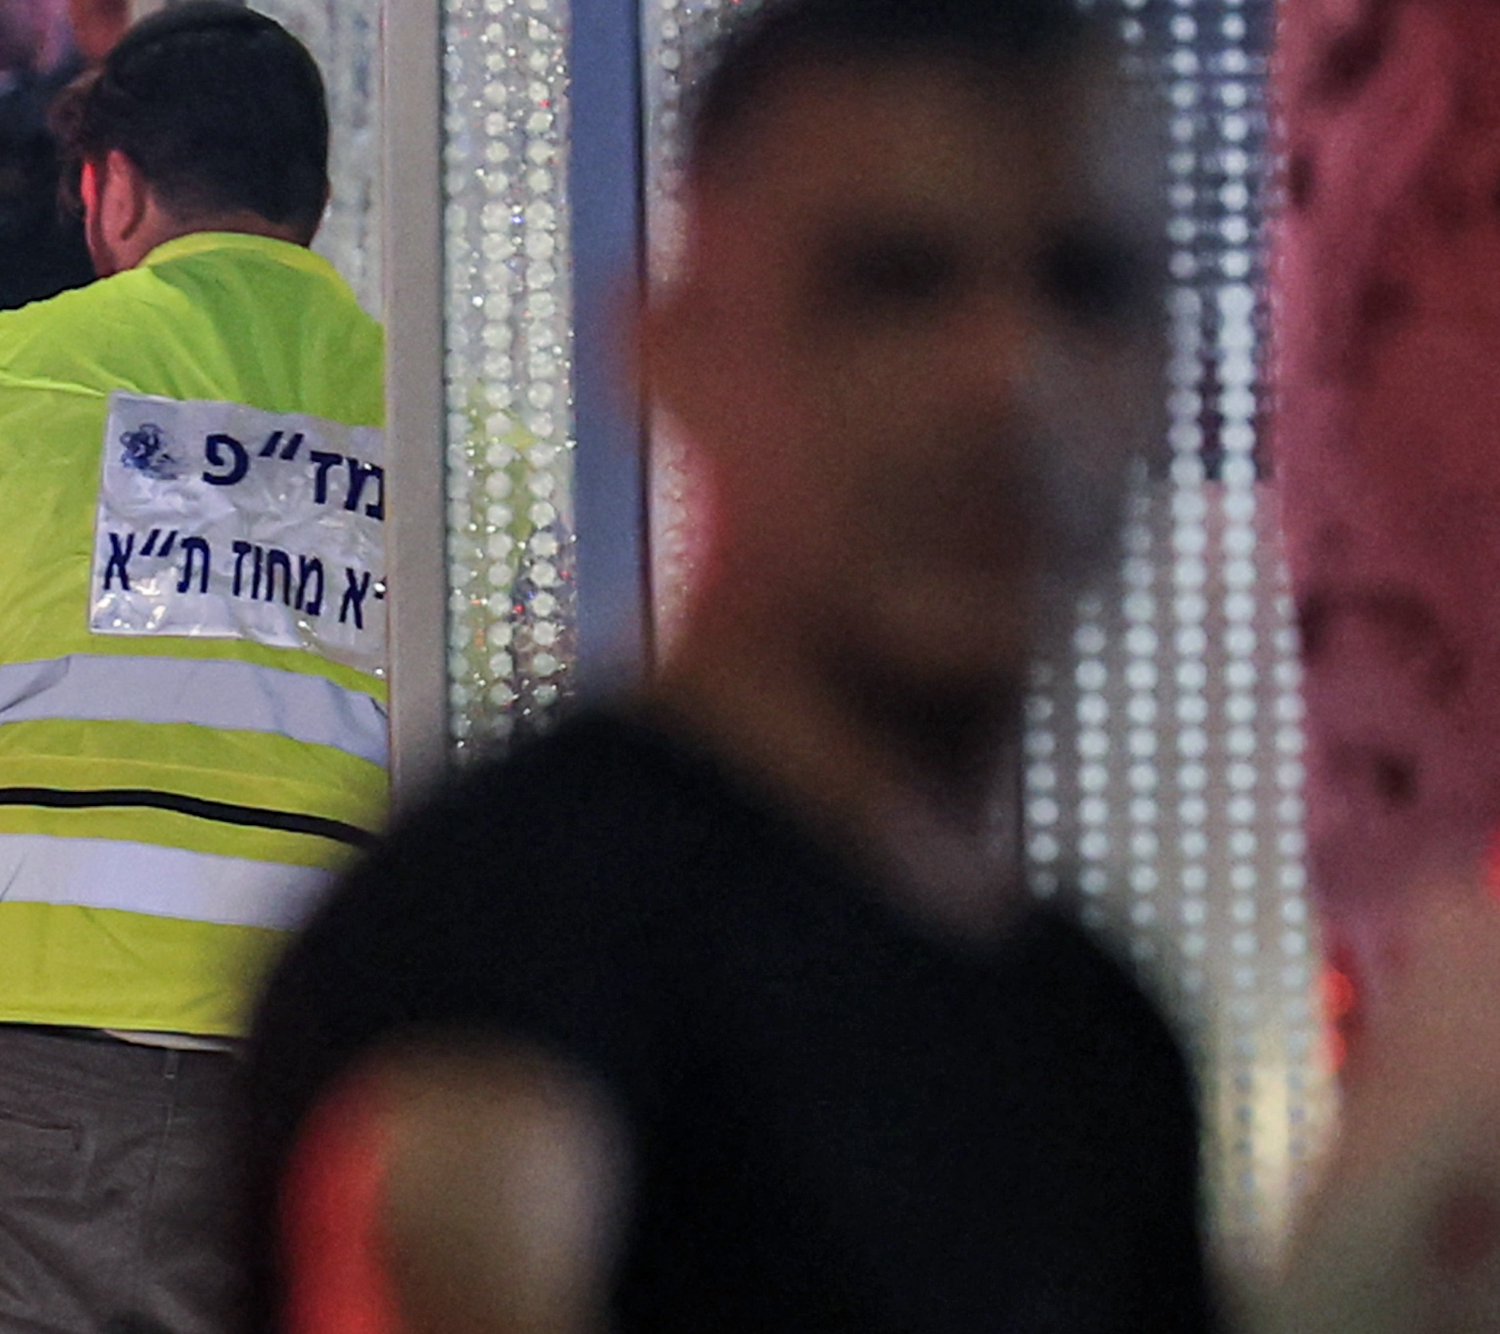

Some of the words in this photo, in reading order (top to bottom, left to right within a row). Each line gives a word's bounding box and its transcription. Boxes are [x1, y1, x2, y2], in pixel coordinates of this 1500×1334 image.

[202, 431, 386, 521] מז"פ
[103, 529, 212, 594] ת"א
[231, 540, 325, 616] מחוז
